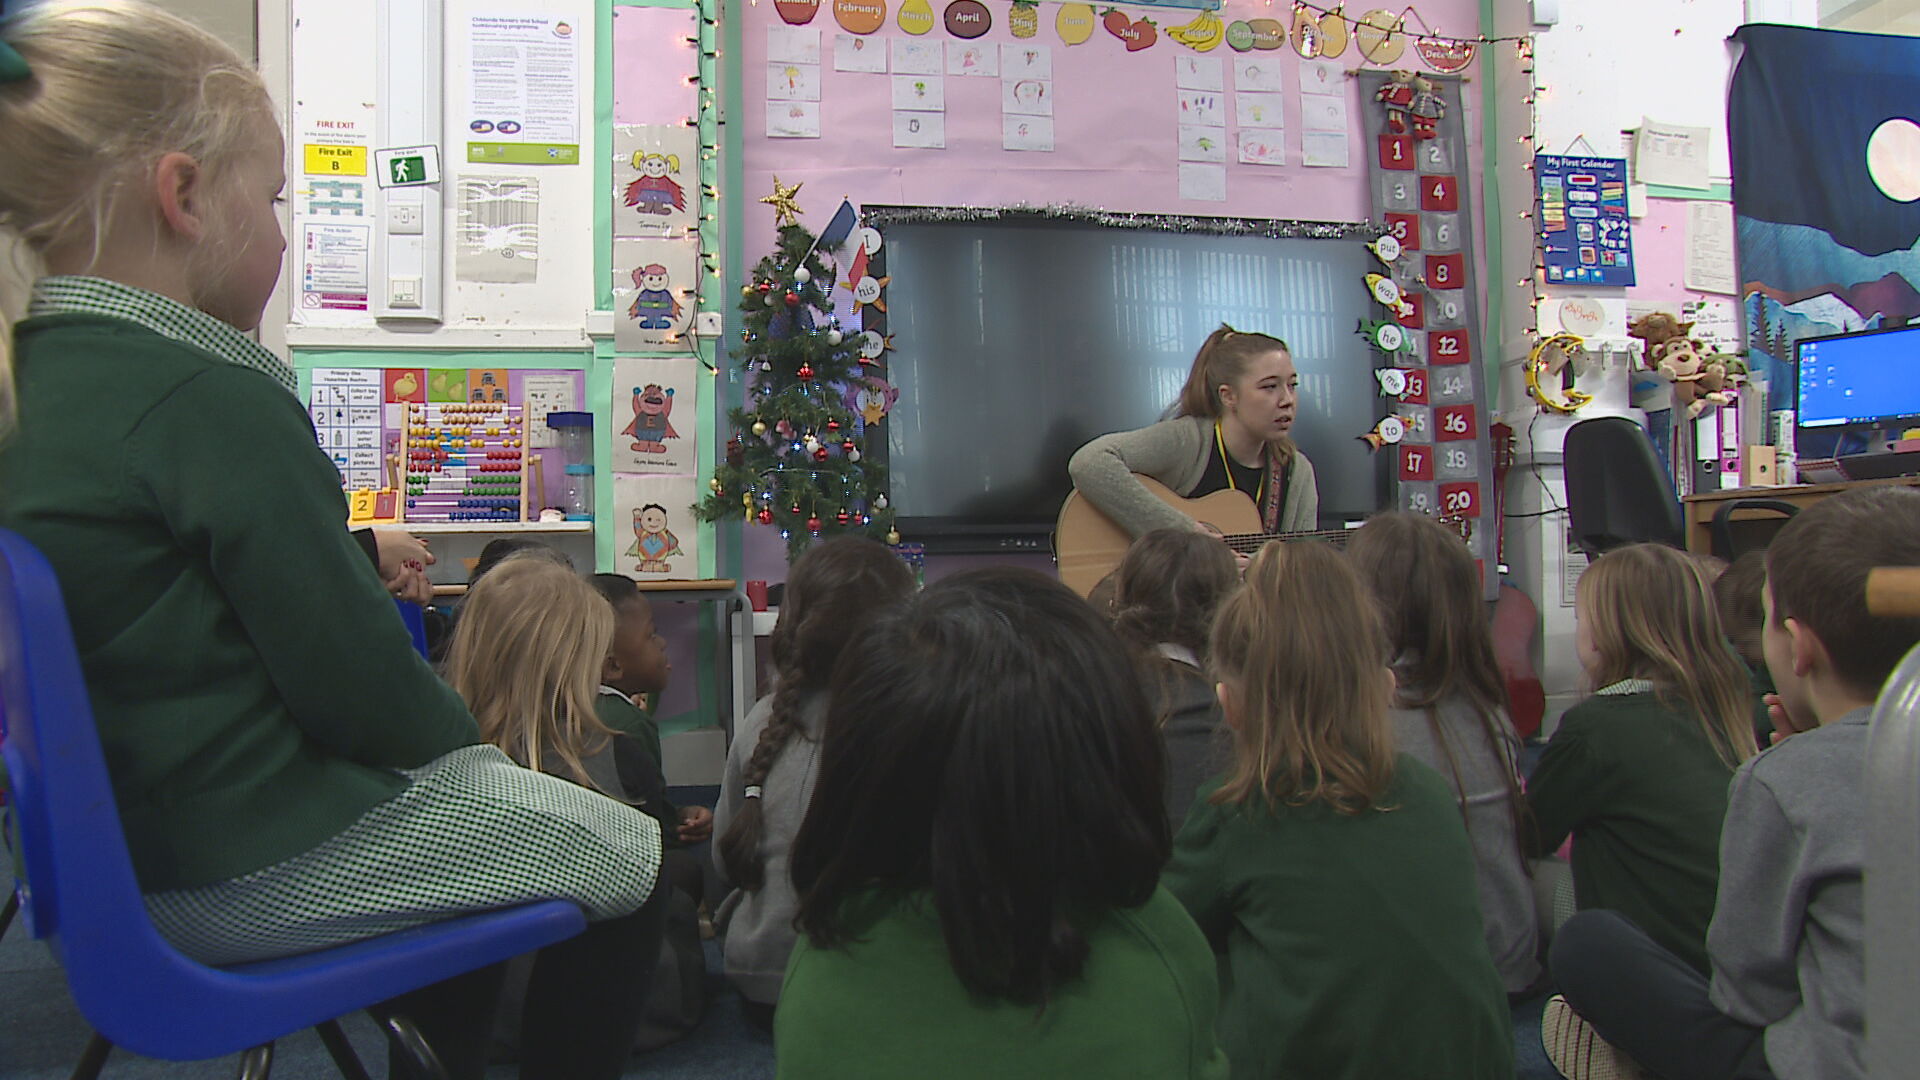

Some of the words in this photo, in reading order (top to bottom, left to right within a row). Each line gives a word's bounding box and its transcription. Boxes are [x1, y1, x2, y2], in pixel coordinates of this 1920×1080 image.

[838, 2, 882, 15] February
[901, 11, 931, 22] March
[955, 12, 980, 23] April
[1013, 18, 1033, 29] May
[1119, 28, 1140, 40] July
[1184, 28, 1216, 38] August
[1232, 28, 1278, 41] September
[316, 120, 334, 129] FIRE
[337, 121, 354, 129] EXIT
[319, 148, 335, 156] Fire
[337, 148, 352, 156] Exit
[1393, 141, 1402, 160] 1
[1429, 146, 1441, 163] 2
[332, 161, 339, 170] B
[1547, 157, 1560, 168] My
[1561, 157, 1579, 167] First
[1580, 159, 1616, 168] Calendar
[1395, 184, 1406, 200] 3
[1432, 183, 1445, 200] 4
[1395, 221, 1407, 239] 5
[1437, 224, 1449, 242] 6
[864, 235, 870, 249] I
[1380, 243, 1396, 254] put
[1436, 265, 1448, 281] 8
[857, 284, 876, 298] his
[1378, 283, 1394, 300] was
[1437, 302, 1456, 319] 10
[1382, 330, 1396, 345] he
[1438, 336, 1458, 355] 12
[1386, 375, 1400, 390] me
[1406, 376, 1422, 396] 13
[1443, 376, 1464, 395] 14
[318, 389, 323, 402] 1
[317, 412, 325, 425] 2
[647, 416, 656, 427] E
[1409, 412, 1425, 431] 15
[1444, 412, 1467, 433] 16
[1386, 427, 1397, 436] to
[319, 433, 324, 445] 3
[1407, 451, 1422, 473] 17
[1446, 449, 1466, 468] 18
[358, 500, 367, 511] 2
[384, 500, 389, 512] 1
[1409, 491, 1427, 512] 19
[1446, 491, 1470, 510] 20
